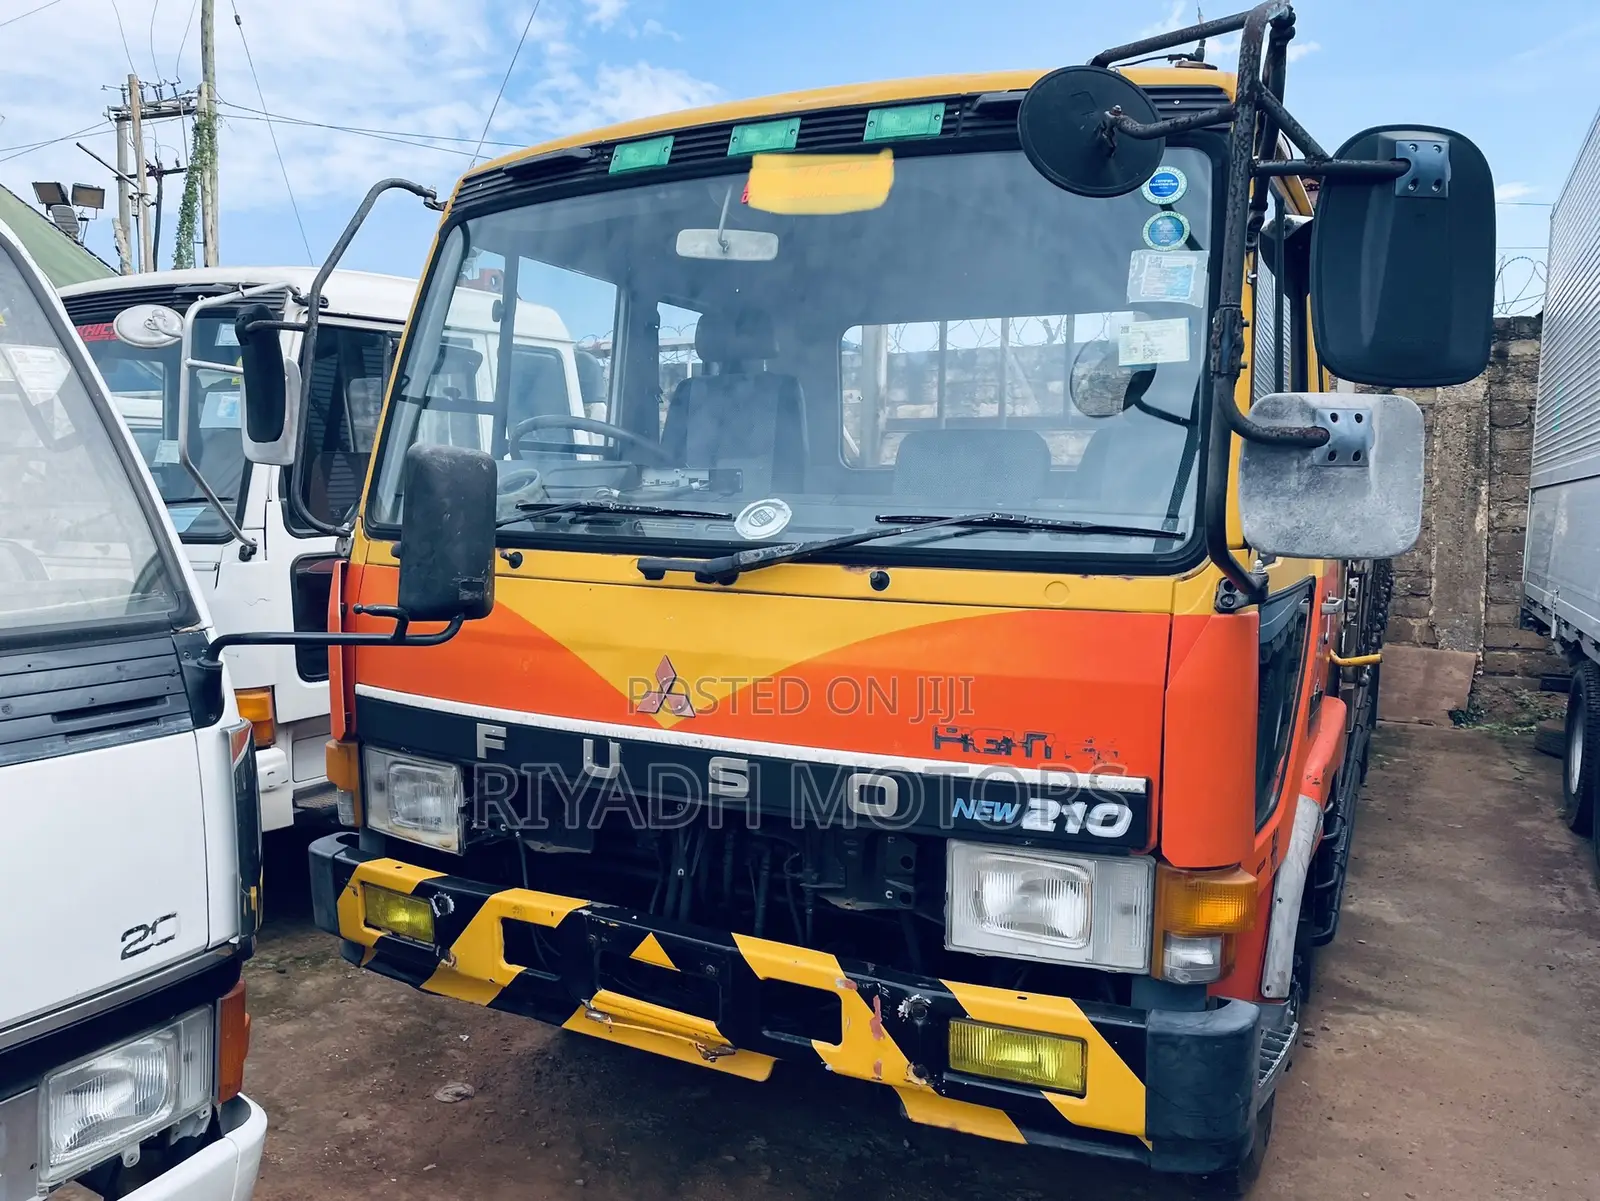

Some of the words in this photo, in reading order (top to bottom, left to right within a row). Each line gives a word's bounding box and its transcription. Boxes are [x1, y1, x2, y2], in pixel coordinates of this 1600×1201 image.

[476, 722, 899, 818] FUSO
[952, 798, 1021, 824] NEW
[1020, 797, 1133, 839] 210
